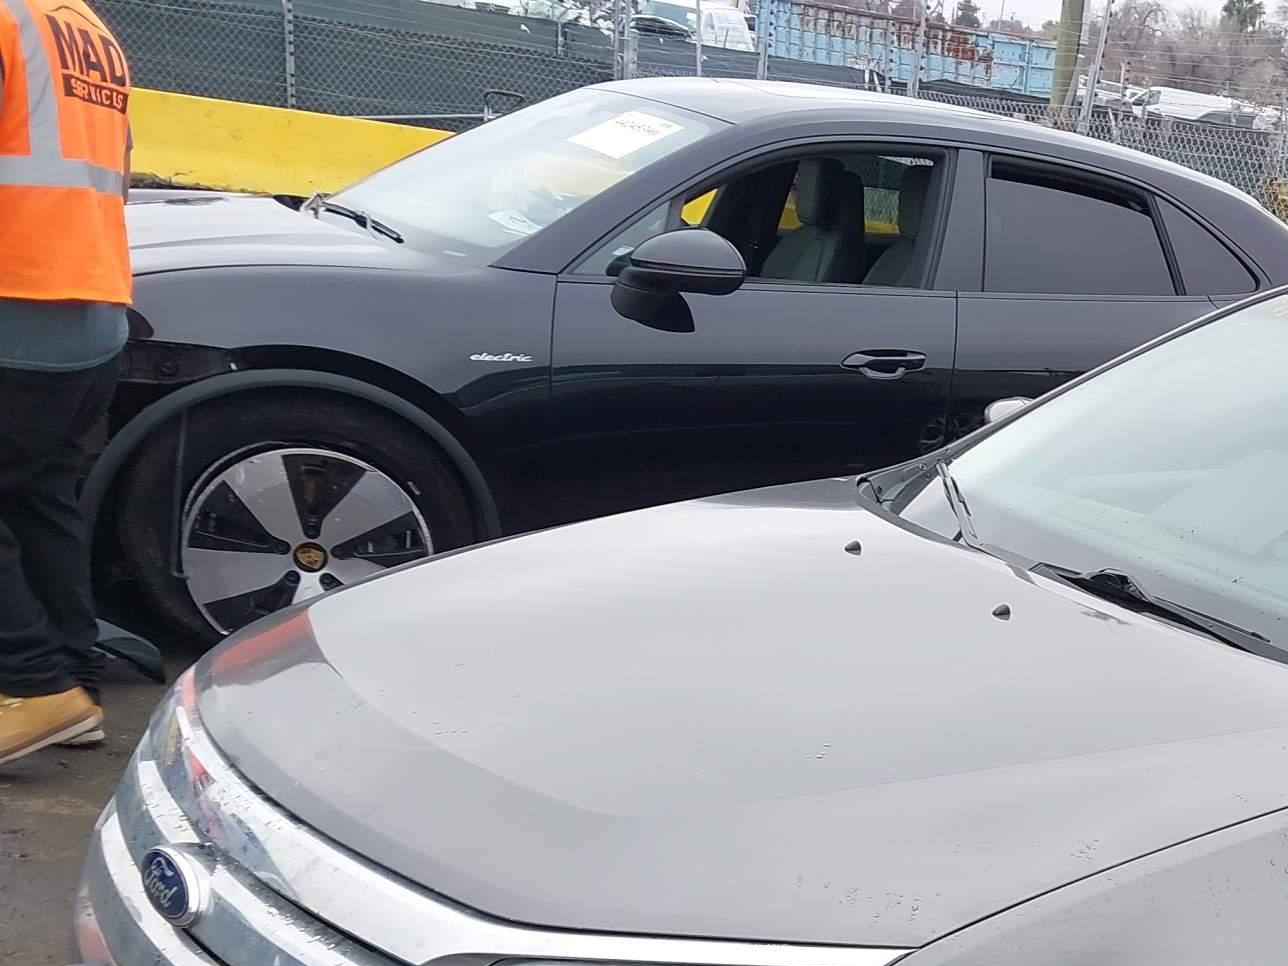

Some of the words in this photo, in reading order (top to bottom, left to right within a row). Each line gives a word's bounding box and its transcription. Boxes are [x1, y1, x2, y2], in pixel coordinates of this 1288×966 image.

[45, 14, 127, 87] MAD
[469, 352, 532, 362] electric
[144, 857, 178, 908] Ford
